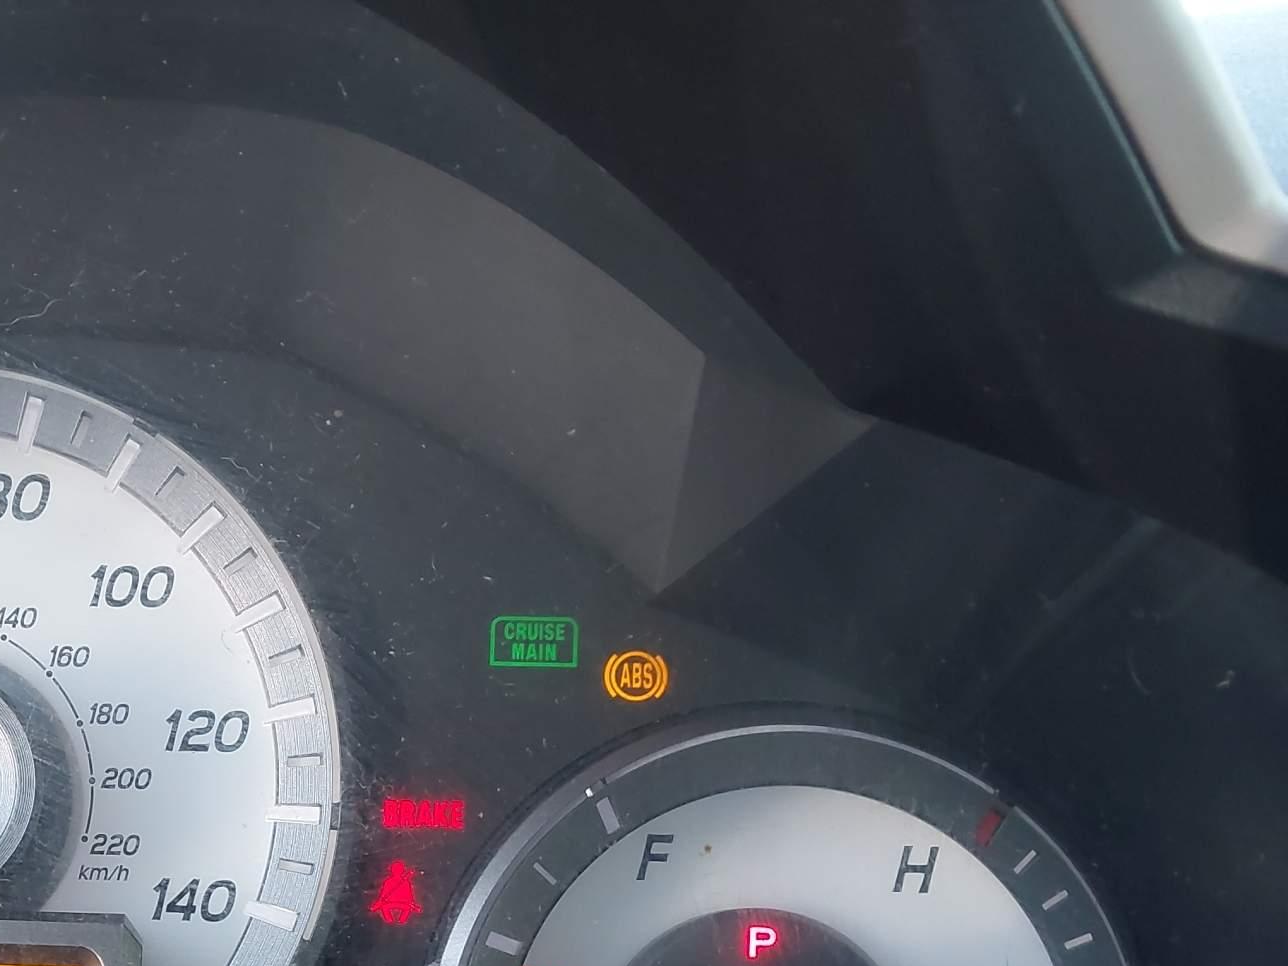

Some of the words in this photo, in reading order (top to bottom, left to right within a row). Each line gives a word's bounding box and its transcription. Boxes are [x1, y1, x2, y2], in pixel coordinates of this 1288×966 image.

[89, 564, 175, 608] 100
[504, 623, 566, 641] CRUISE
[48, 646, 91, 668] 160
[512, 643, 557, 662] MAIN
[620, 662, 654, 690] ABS
[89, 703, 130, 726] 180
[165, 709, 250, 753] 120
[100, 767, 152, 790] 200
[382, 799, 465, 829] BRAKE
[89, 834, 141, 856] 220
[636, 833, 674, 881] F
[77, 864, 130, 882] km/h
[892, 845, 939, 893] H
[151, 878, 237, 923] 140
[748, 926, 777, 959] P
